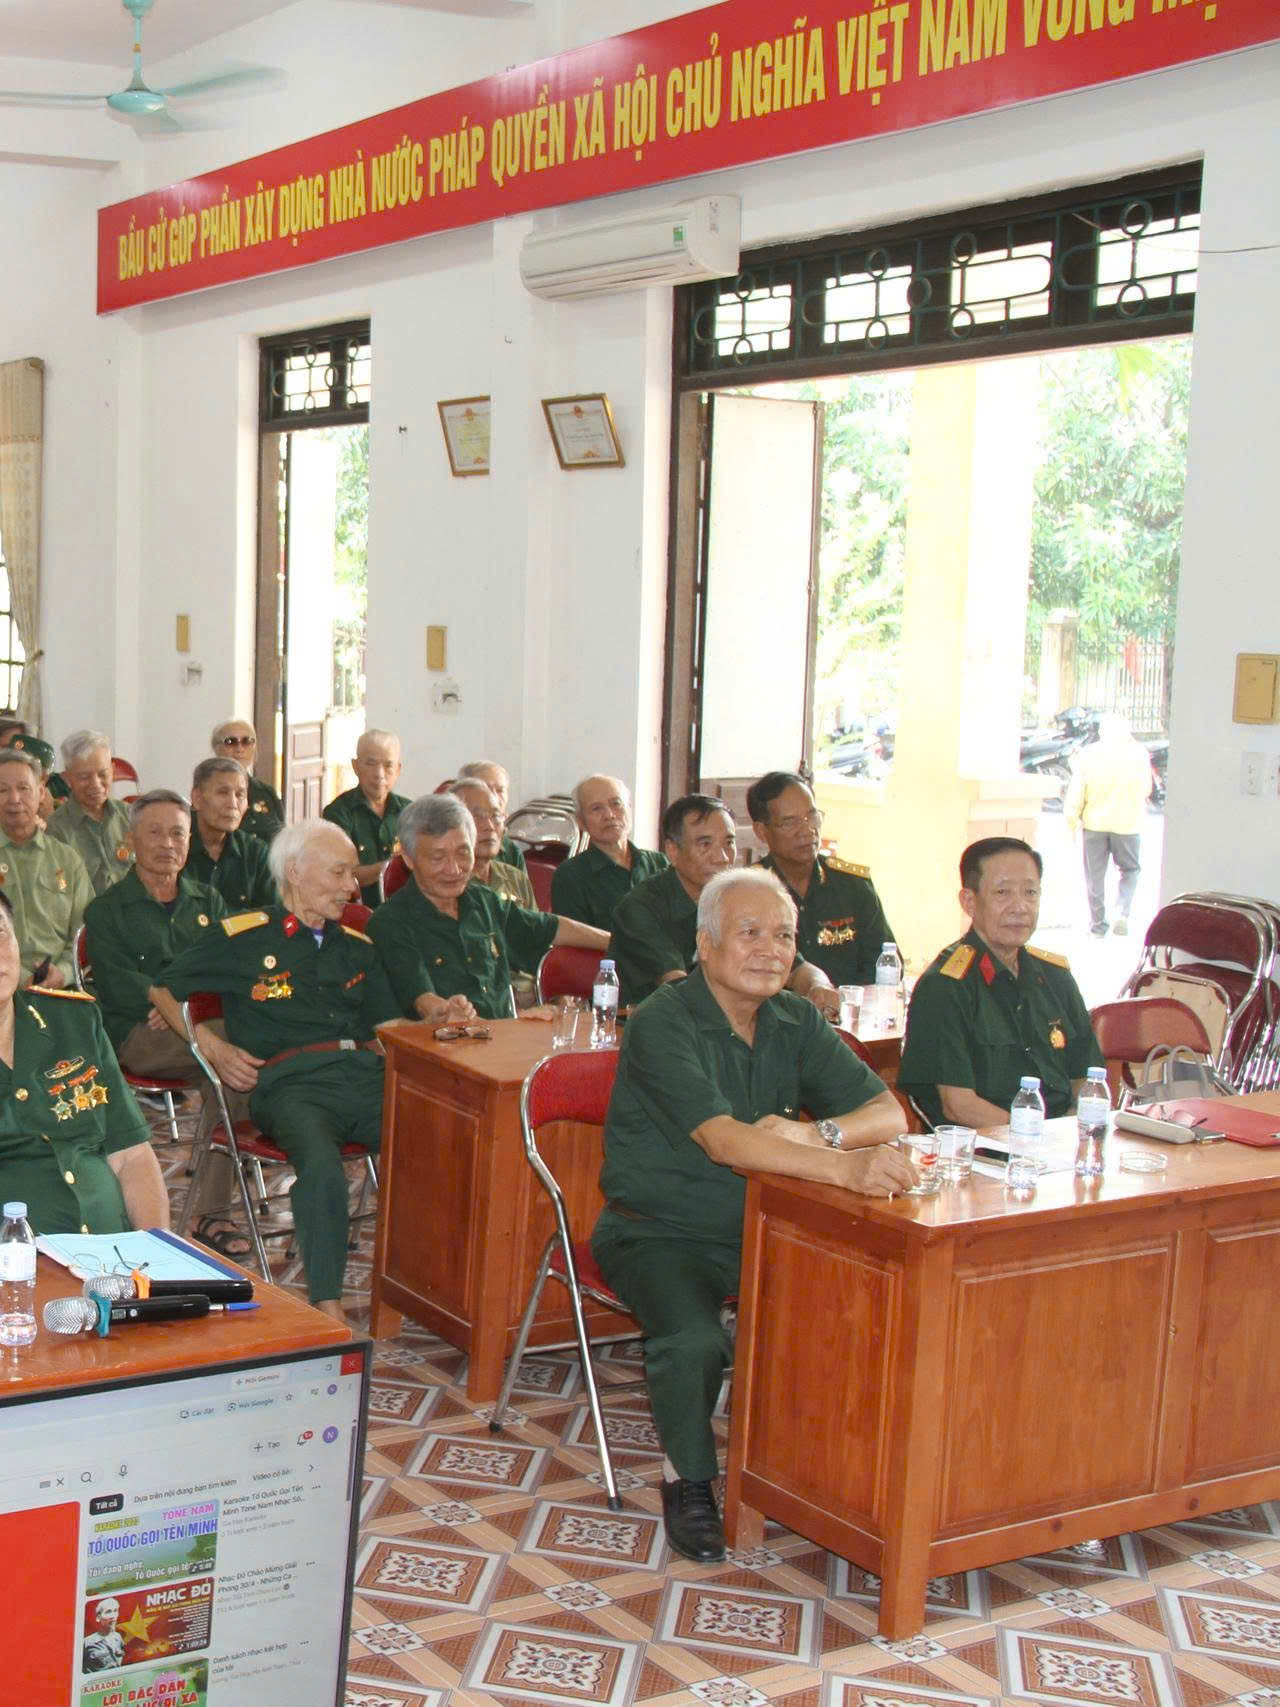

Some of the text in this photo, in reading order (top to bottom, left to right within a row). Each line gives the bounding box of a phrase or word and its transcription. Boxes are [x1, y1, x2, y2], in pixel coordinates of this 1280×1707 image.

[119, 215, 144, 281] BẦU
[148, 206, 167, 273] CỬ
[169, 206, 196, 268] GÓP
[200, 185, 241, 258] PHẦN
[244, 180, 275, 247] XÂY
[279, 174, 325, 247] DỰNG
[329, 149, 367, 225] NHÀ
[371, 135, 424, 213] NƯỚC
[429, 115, 485, 197] PHÁP
[490, 84, 566, 188] QUYỀN
[572, 76, 607, 161] XÃ
[614, 63, 658, 162] HỘI
[665, 32, 722, 138] CHỦ
[730, 18, 826, 122] NGHĨA
[837, 0, 910, 106] VIỆT
[918, 0, 1009, 77] NAM
[163, 1503, 215, 1520] TONE NAM
[106, 1530, 138, 1552] QUỐC
[146, 1587, 187, 1607] NHẠC
[190, 1577, 212, 1598] ĐỎ
[83, 1680, 122, 1695] KARAOKE
[181, 1691, 199, 1706] XA
